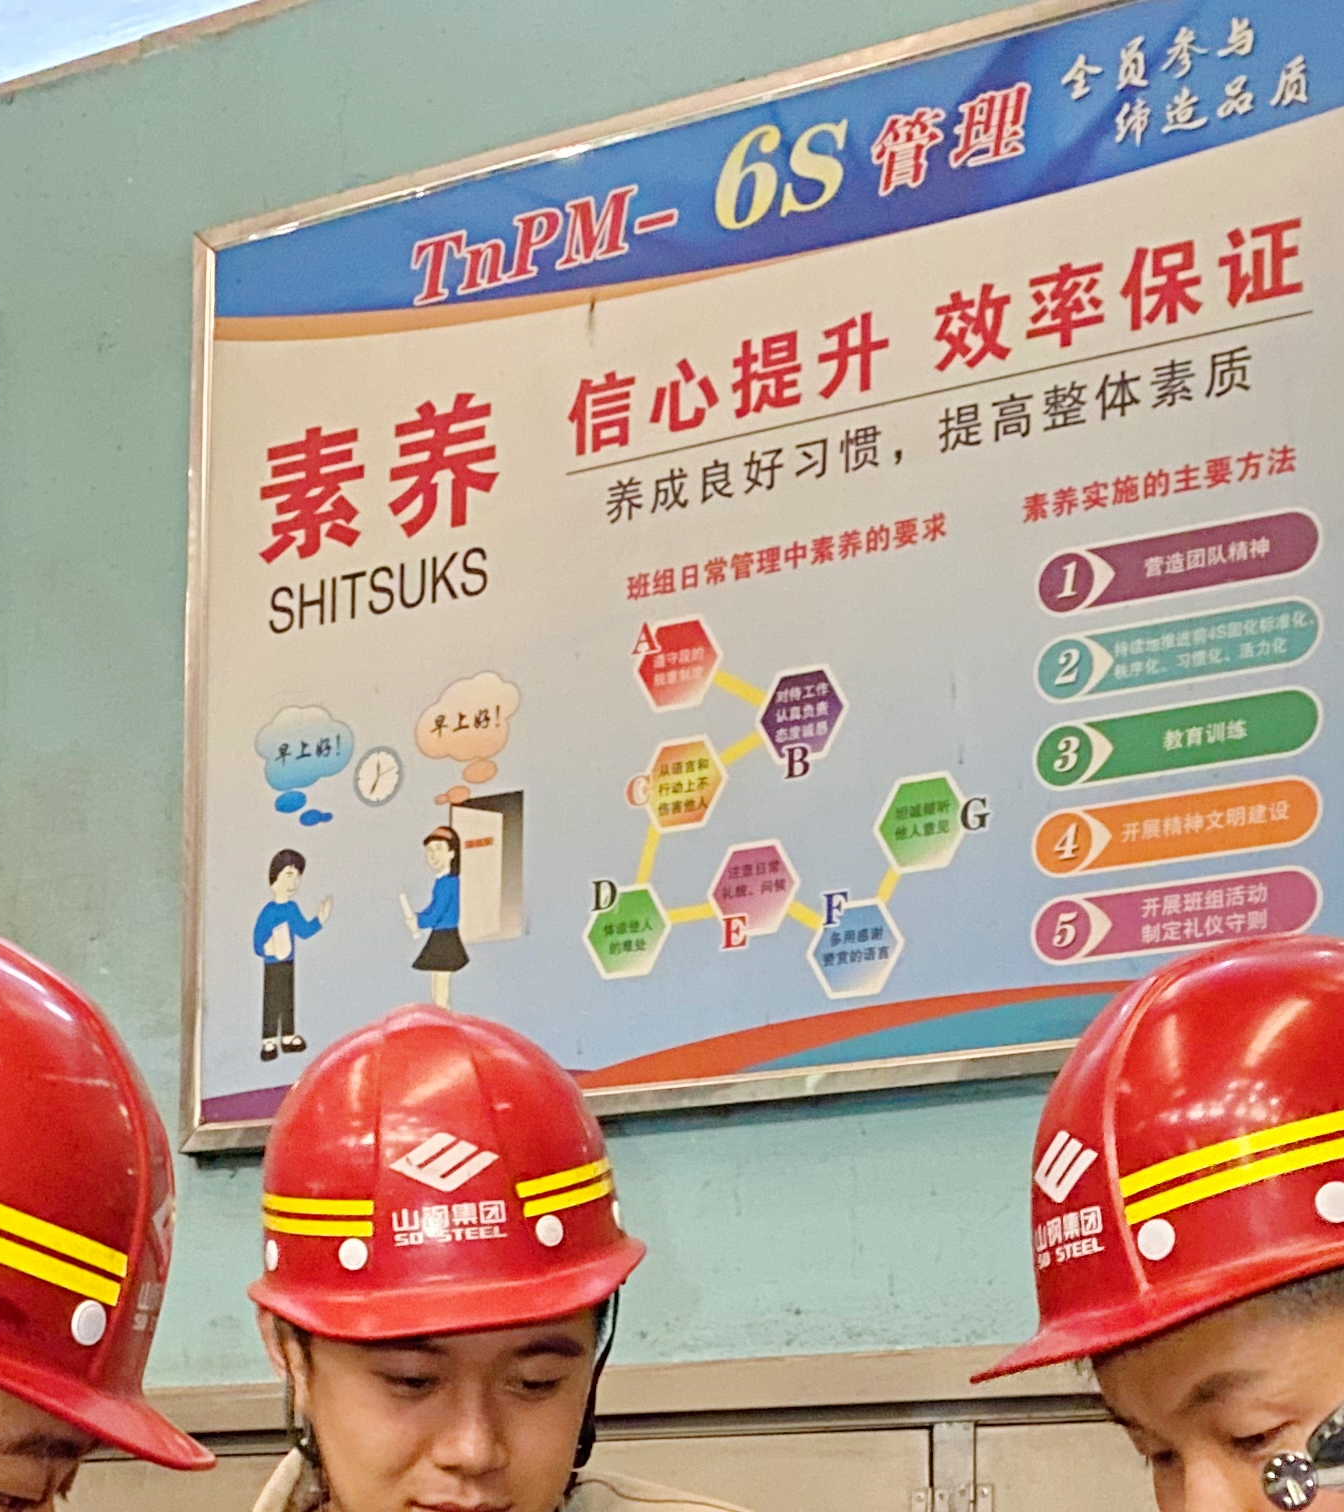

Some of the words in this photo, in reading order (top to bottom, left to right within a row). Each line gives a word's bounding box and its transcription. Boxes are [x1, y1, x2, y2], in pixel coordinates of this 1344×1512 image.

[1061, 16, 1255, 102] 全员参与
[1115, 54, 1311, 146] 缔造品质
[410, 185, 679, 307] TnPM-
[714, 117, 849, 231] 6S
[870, 82, 1032, 195] 管理
[568, 310, 890, 457] 信心提升
[934, 216, 1304, 371] 效率保证
[605, 344, 1253, 525] 养成良好习惯，提高整体素质
[259, 392, 500, 565] 素养
[1022, 444, 1297, 523] 素养实施的主要方法
[626, 511, 948, 601] 班组日常管理中素养的要求
[1056, 560, 1079, 600] 1
[1144, 536, 1271, 578] 营造团队精神
[269, 547, 488, 634] SHITSUKS
[632, 621, 661, 655] A
[1054, 647, 1081, 687] 2
[784, 745, 811, 780] B
[1053, 735, 1081, 773] 3
[1162, 719, 1248, 751] 教育训练
[626, 774, 651, 807] C
[960, 797, 991, 831] G
[1053, 822, 1080, 862] 4
[1120, 800, 1292, 843] 开展精神文明建设
[591, 879, 618, 912] D
[822, 891, 849, 926] F
[1141, 882, 1269, 919] 开展班组活动
[722, 916, 747, 950] E
[1052, 911, 1080, 949] 5
[1140, 908, 1268, 945] 制定礼仪守则
[1056, 1237, 1105, 1264] STEEL
